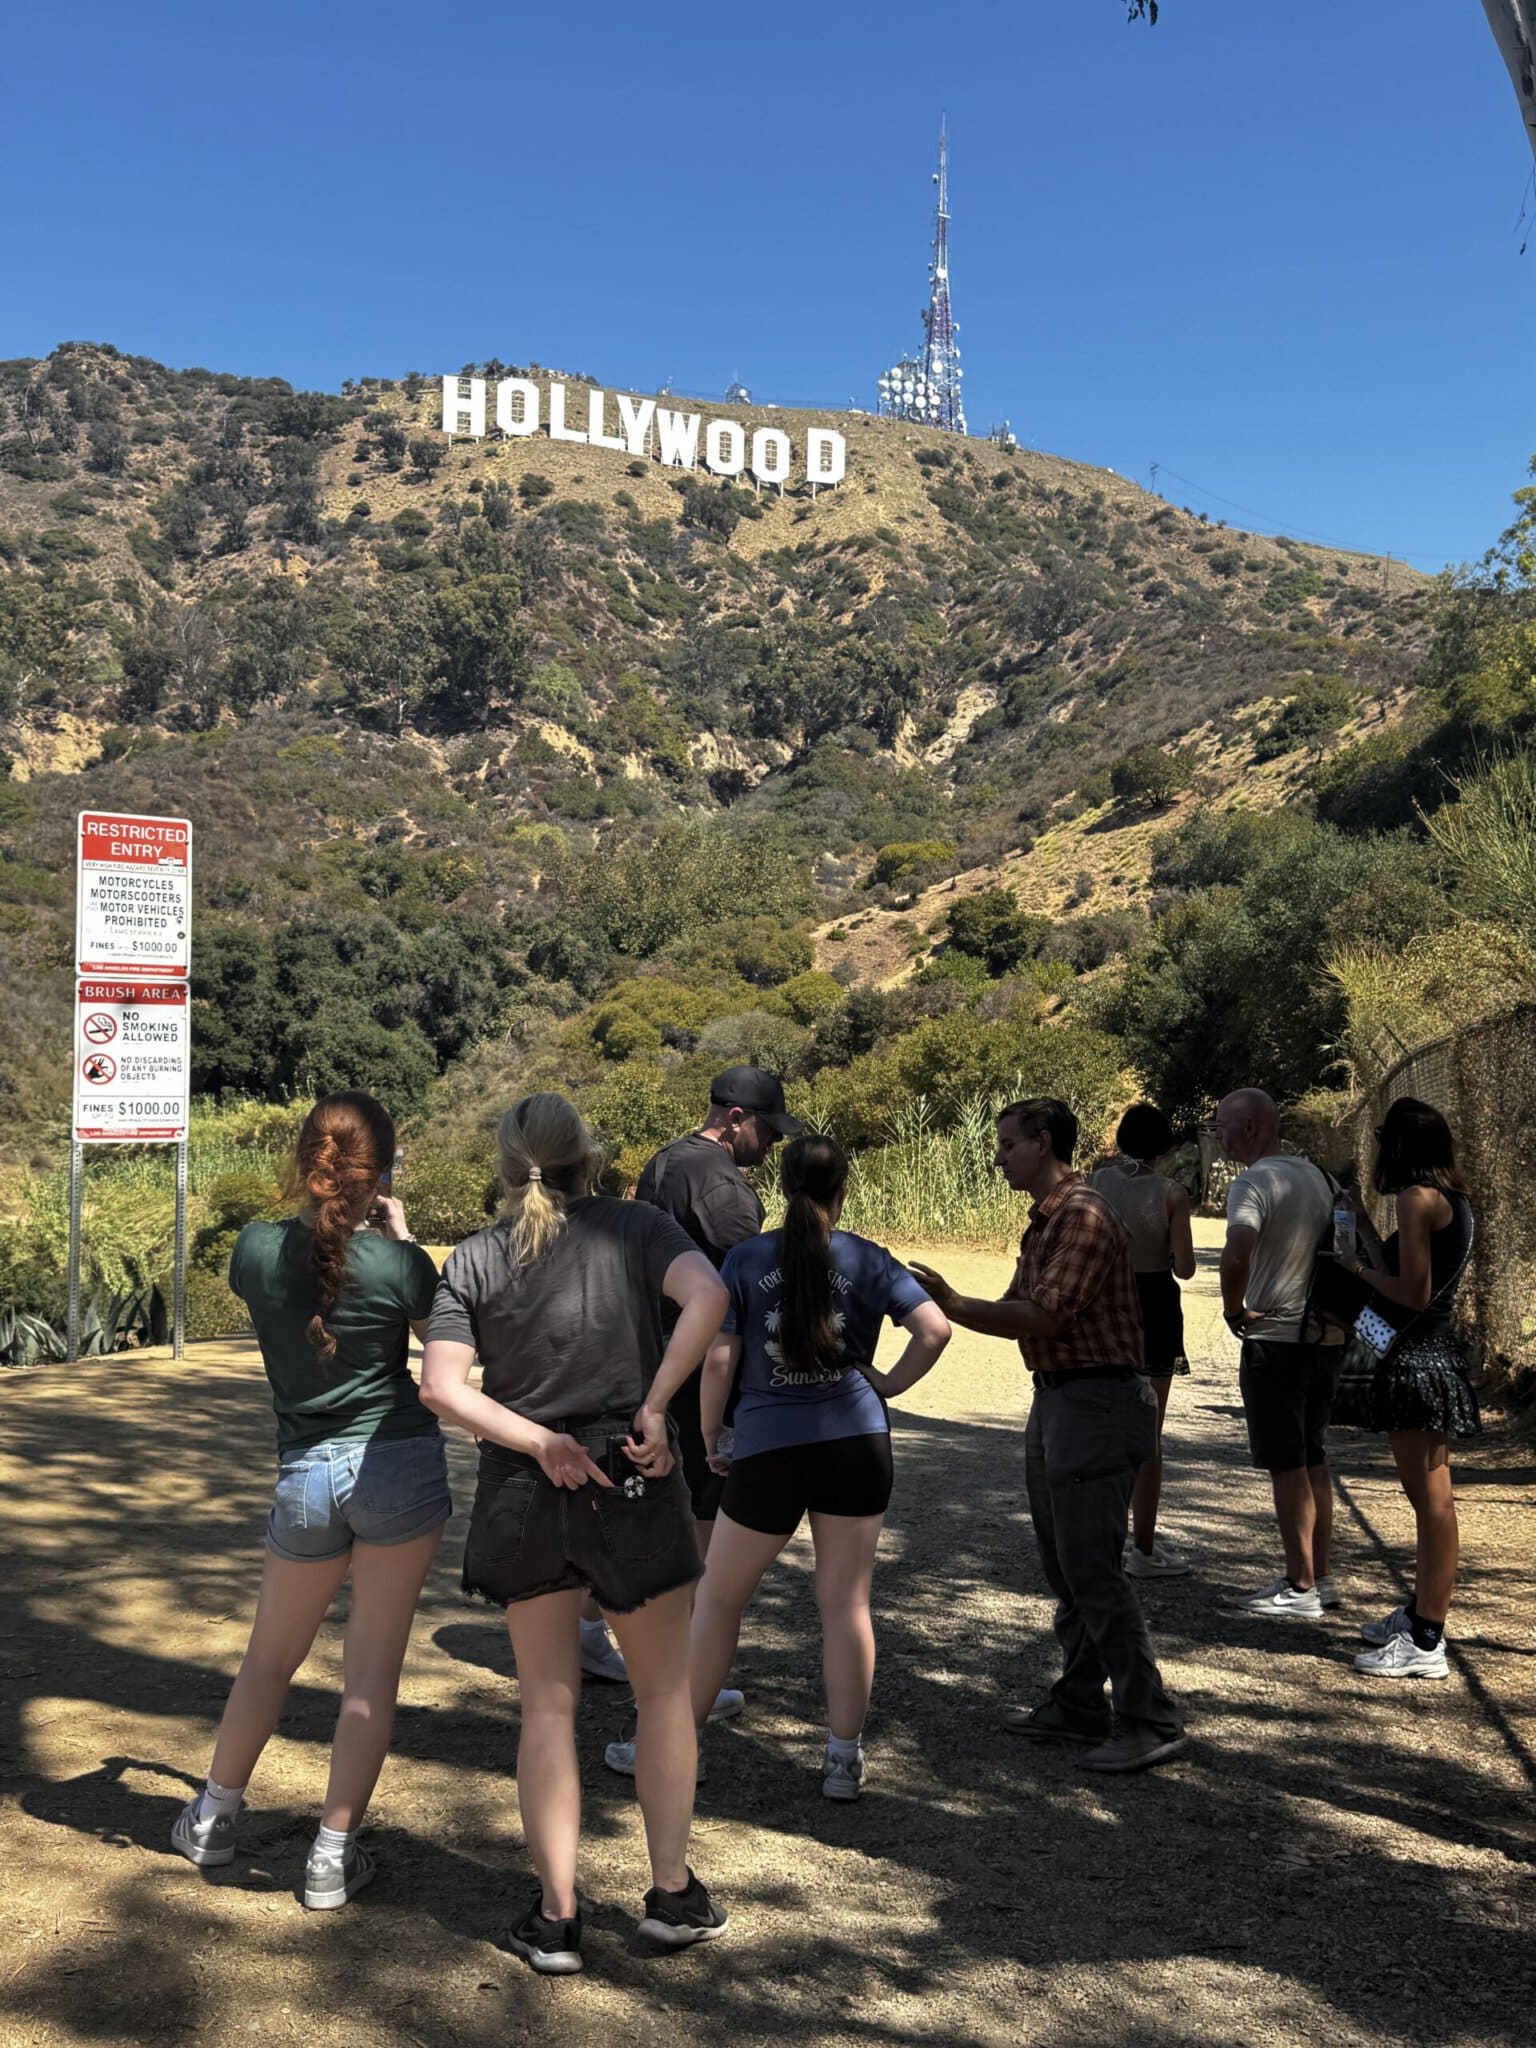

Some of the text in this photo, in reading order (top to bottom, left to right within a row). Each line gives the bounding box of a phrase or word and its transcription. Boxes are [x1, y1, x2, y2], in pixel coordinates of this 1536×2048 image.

[442, 375, 846, 484] HOLLYWOOD
[87, 822, 186, 842] RESTRICTED
[111, 842, 163, 858] ENTRY
[99, 876, 174, 890] MOTORCYCLES
[91, 888, 181, 903] MOTORSCOOTERS
[100, 902, 134, 914] MOTOR
[137, 903, 184, 917] VEHICLES
[105, 915, 167, 928] PROHIBITED
[90, 941, 115, 950] FINES
[85, 986, 181, 999] BRUSH AREA
[122, 1012, 140, 1021] NO
[122, 1022, 178, 1032] SMOKING
[122, 1032, 178, 1042] ALLOWED
[134, 1056, 182, 1064] DISCARDING
[121, 1064, 130, 1072] OF
[83, 1102, 180, 1115] FINES $1000.00
